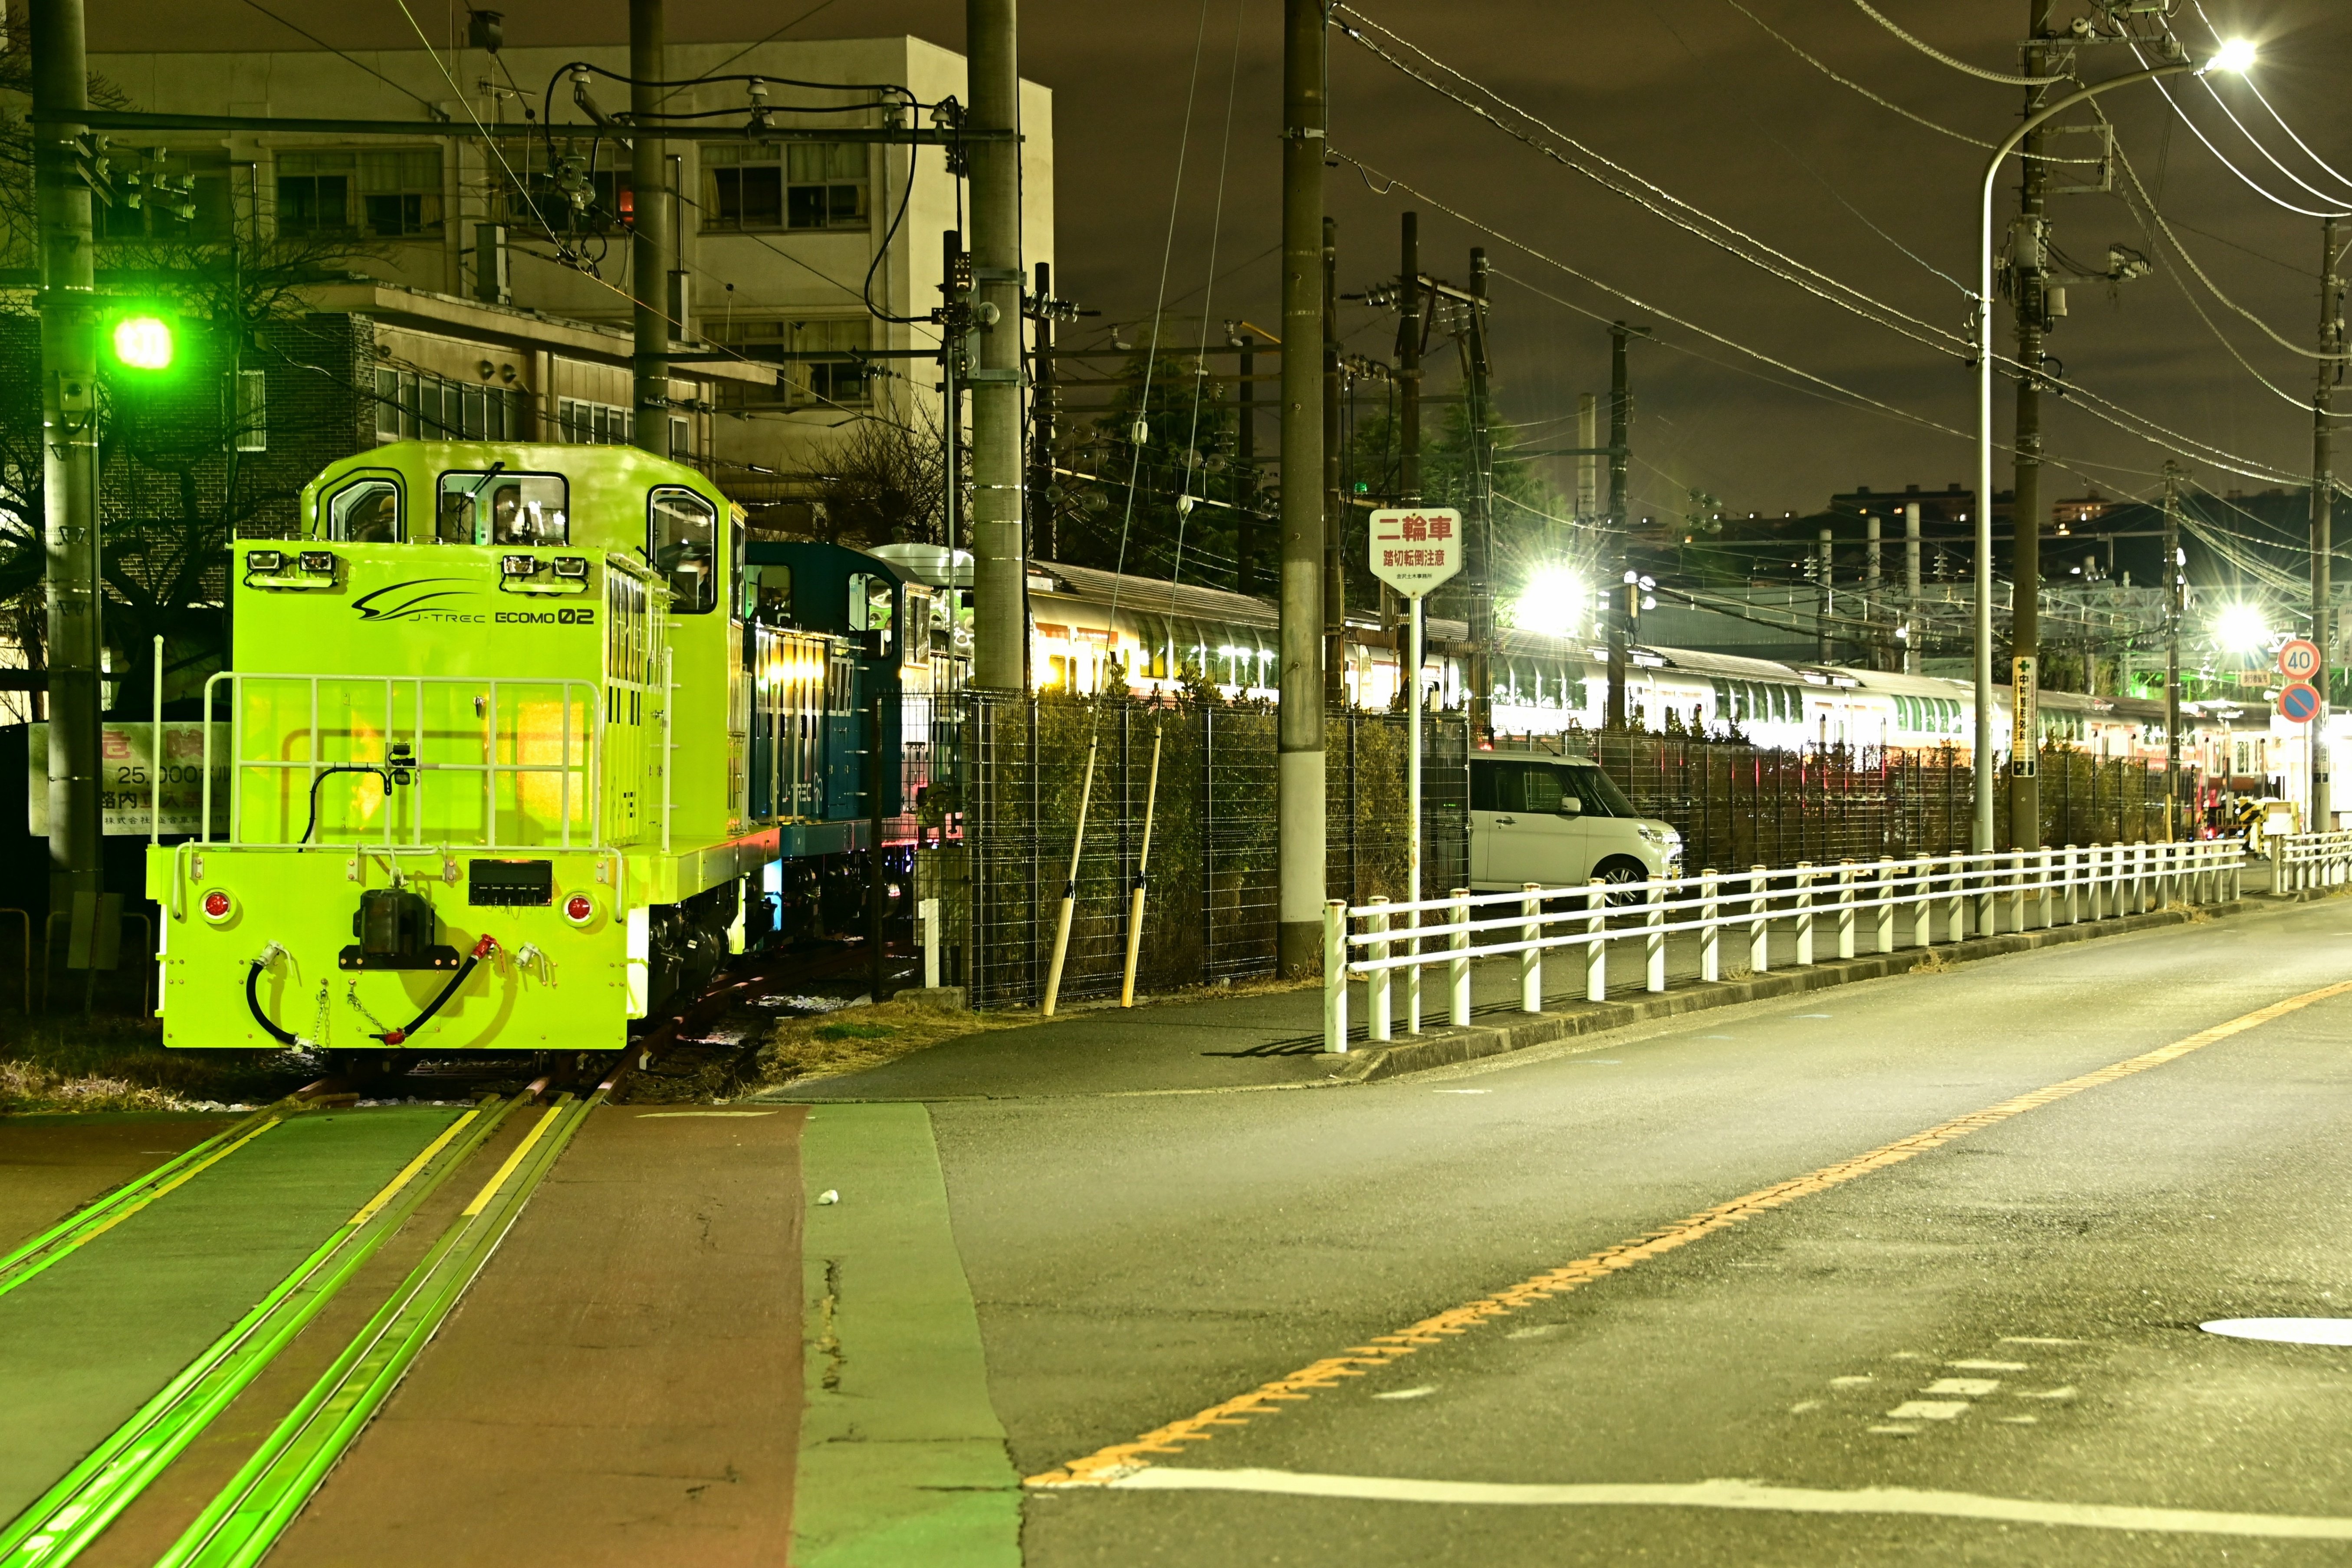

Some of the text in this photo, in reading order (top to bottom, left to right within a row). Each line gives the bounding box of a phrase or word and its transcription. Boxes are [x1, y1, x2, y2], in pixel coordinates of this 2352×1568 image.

[1377, 516, 1453, 542] 二輪車
[1383, 549, 1445, 566] 踏切転倒注意
[409, 614, 486, 623] J-TREC
[495, 608, 595, 625] ECOMO 02
[2288, 652, 2310, 669] 40
